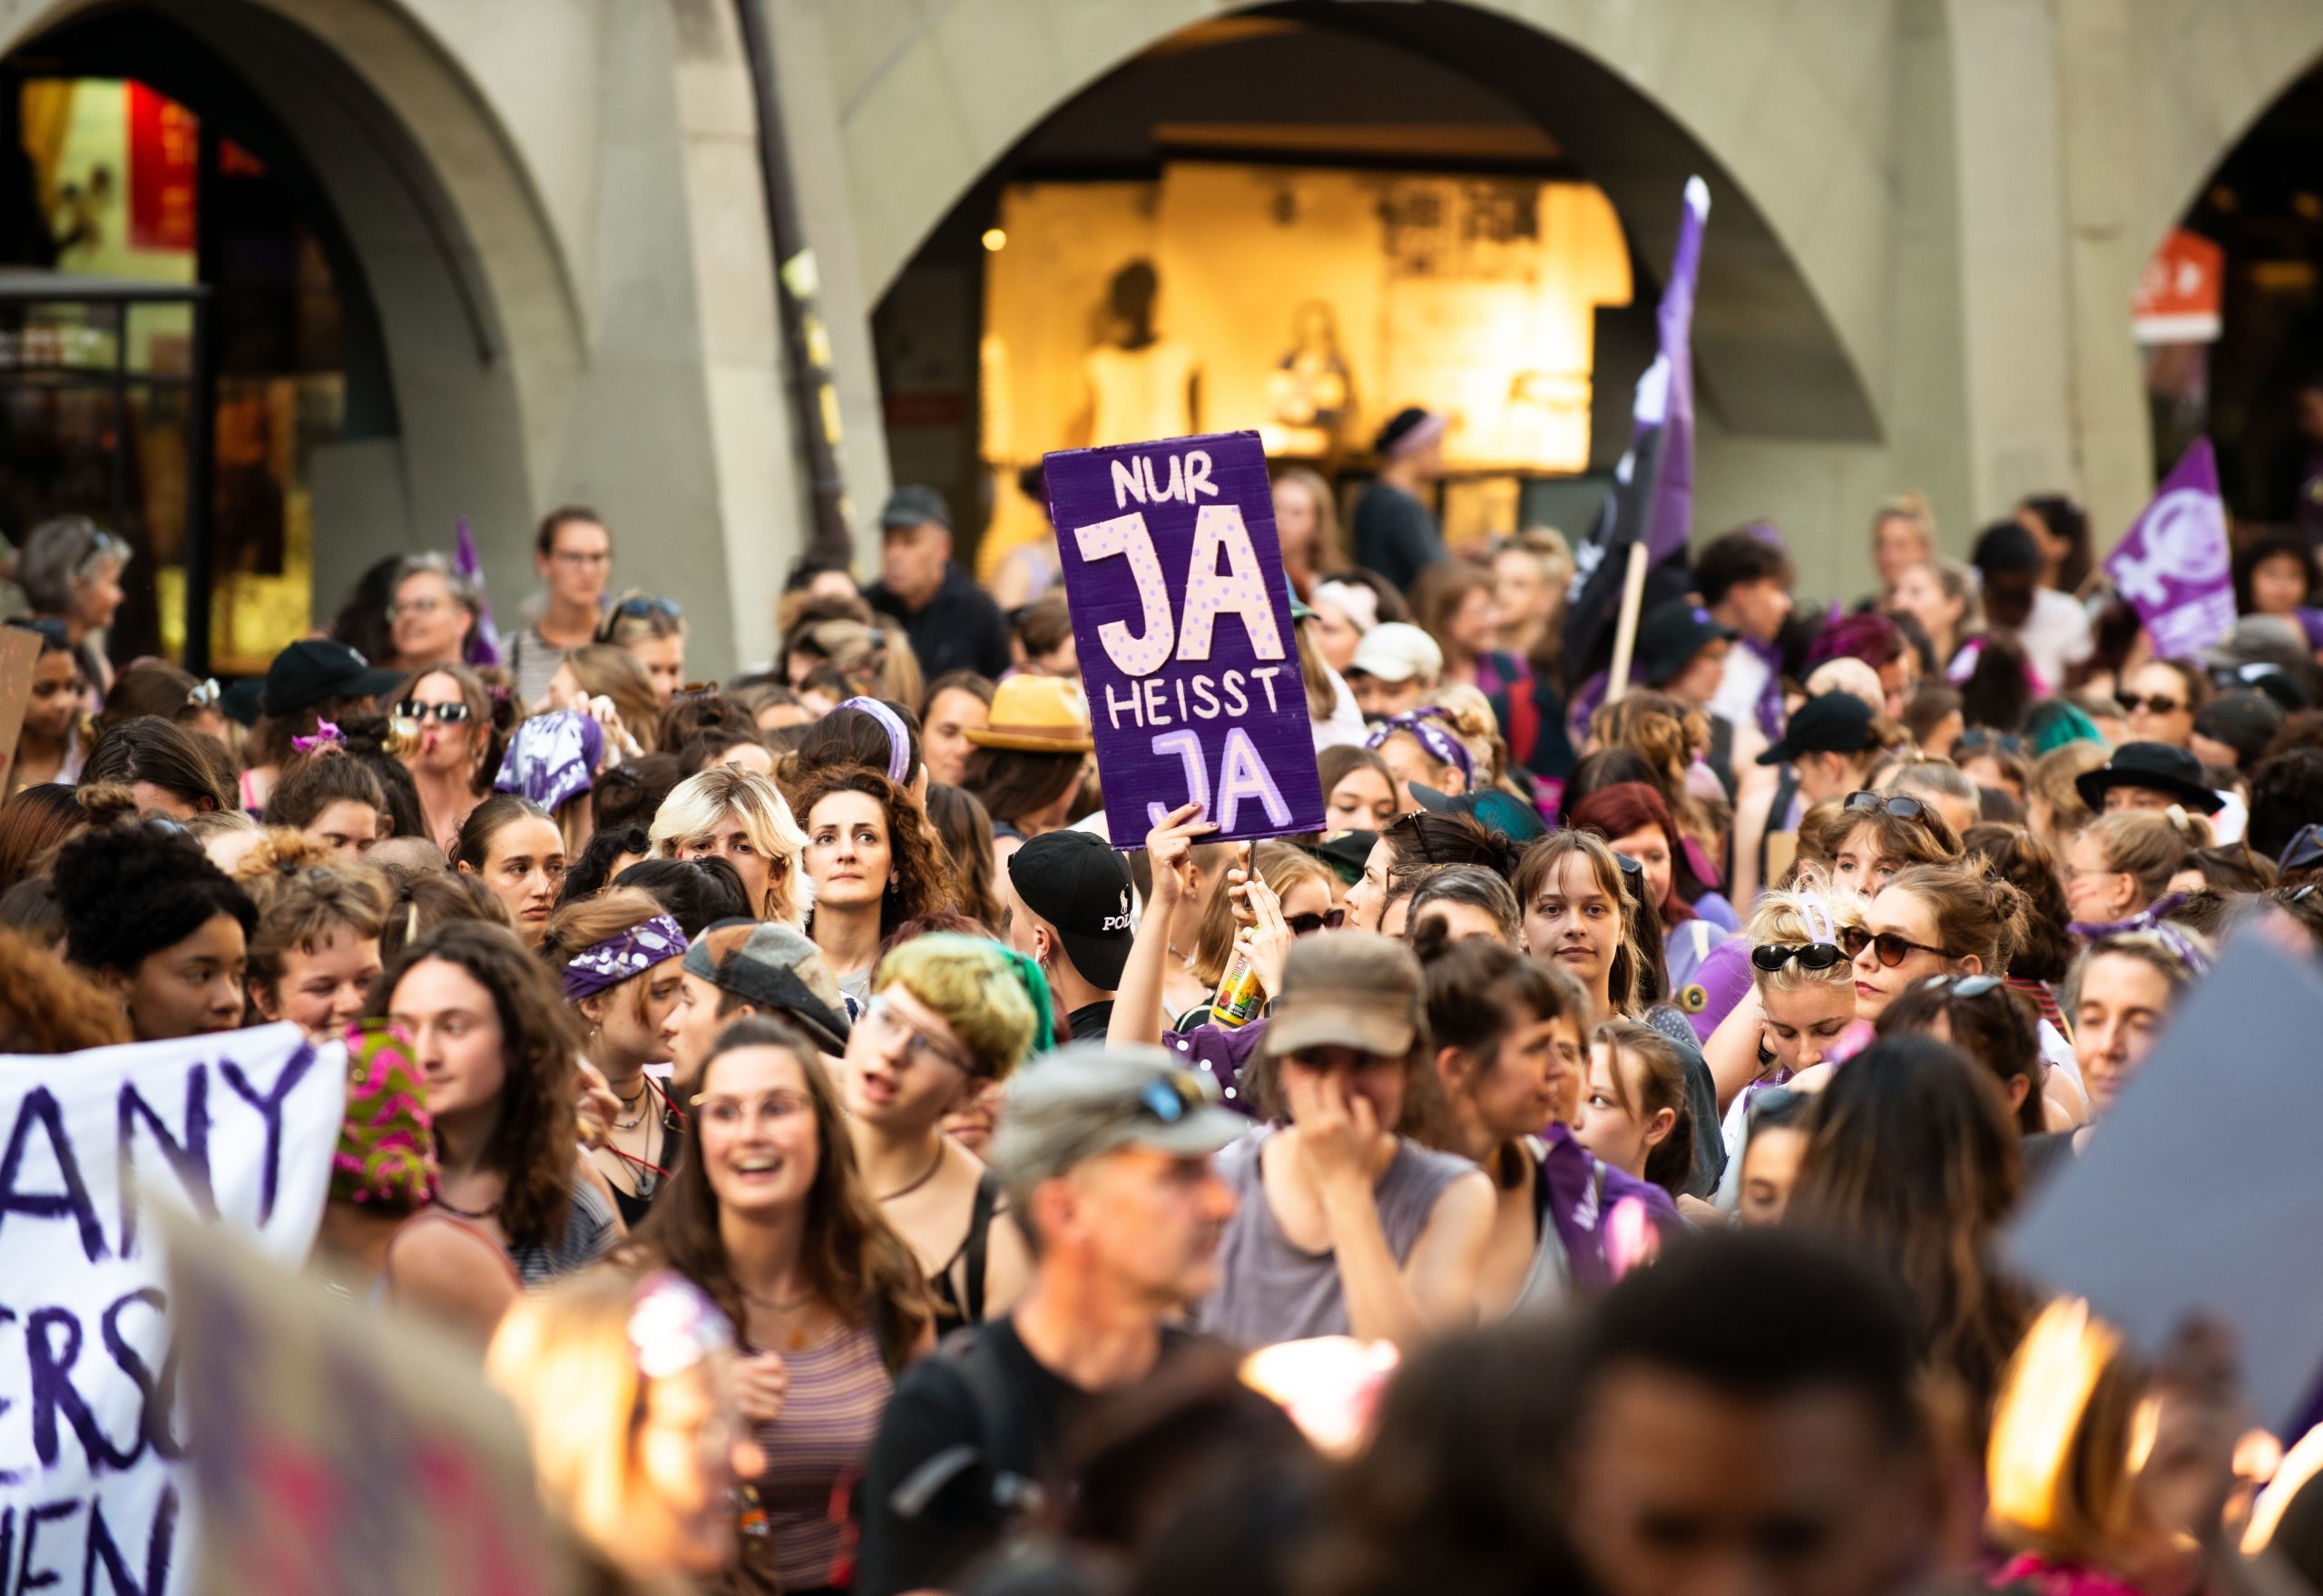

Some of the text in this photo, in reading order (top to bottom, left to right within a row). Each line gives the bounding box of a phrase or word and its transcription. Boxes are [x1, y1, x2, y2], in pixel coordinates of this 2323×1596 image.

[1111, 450, 1219, 509] NUR
[1073, 504, 1286, 676] JA
[1105, 667, 1281, 729] HEISST
[1146, 727, 1293, 833] JA
